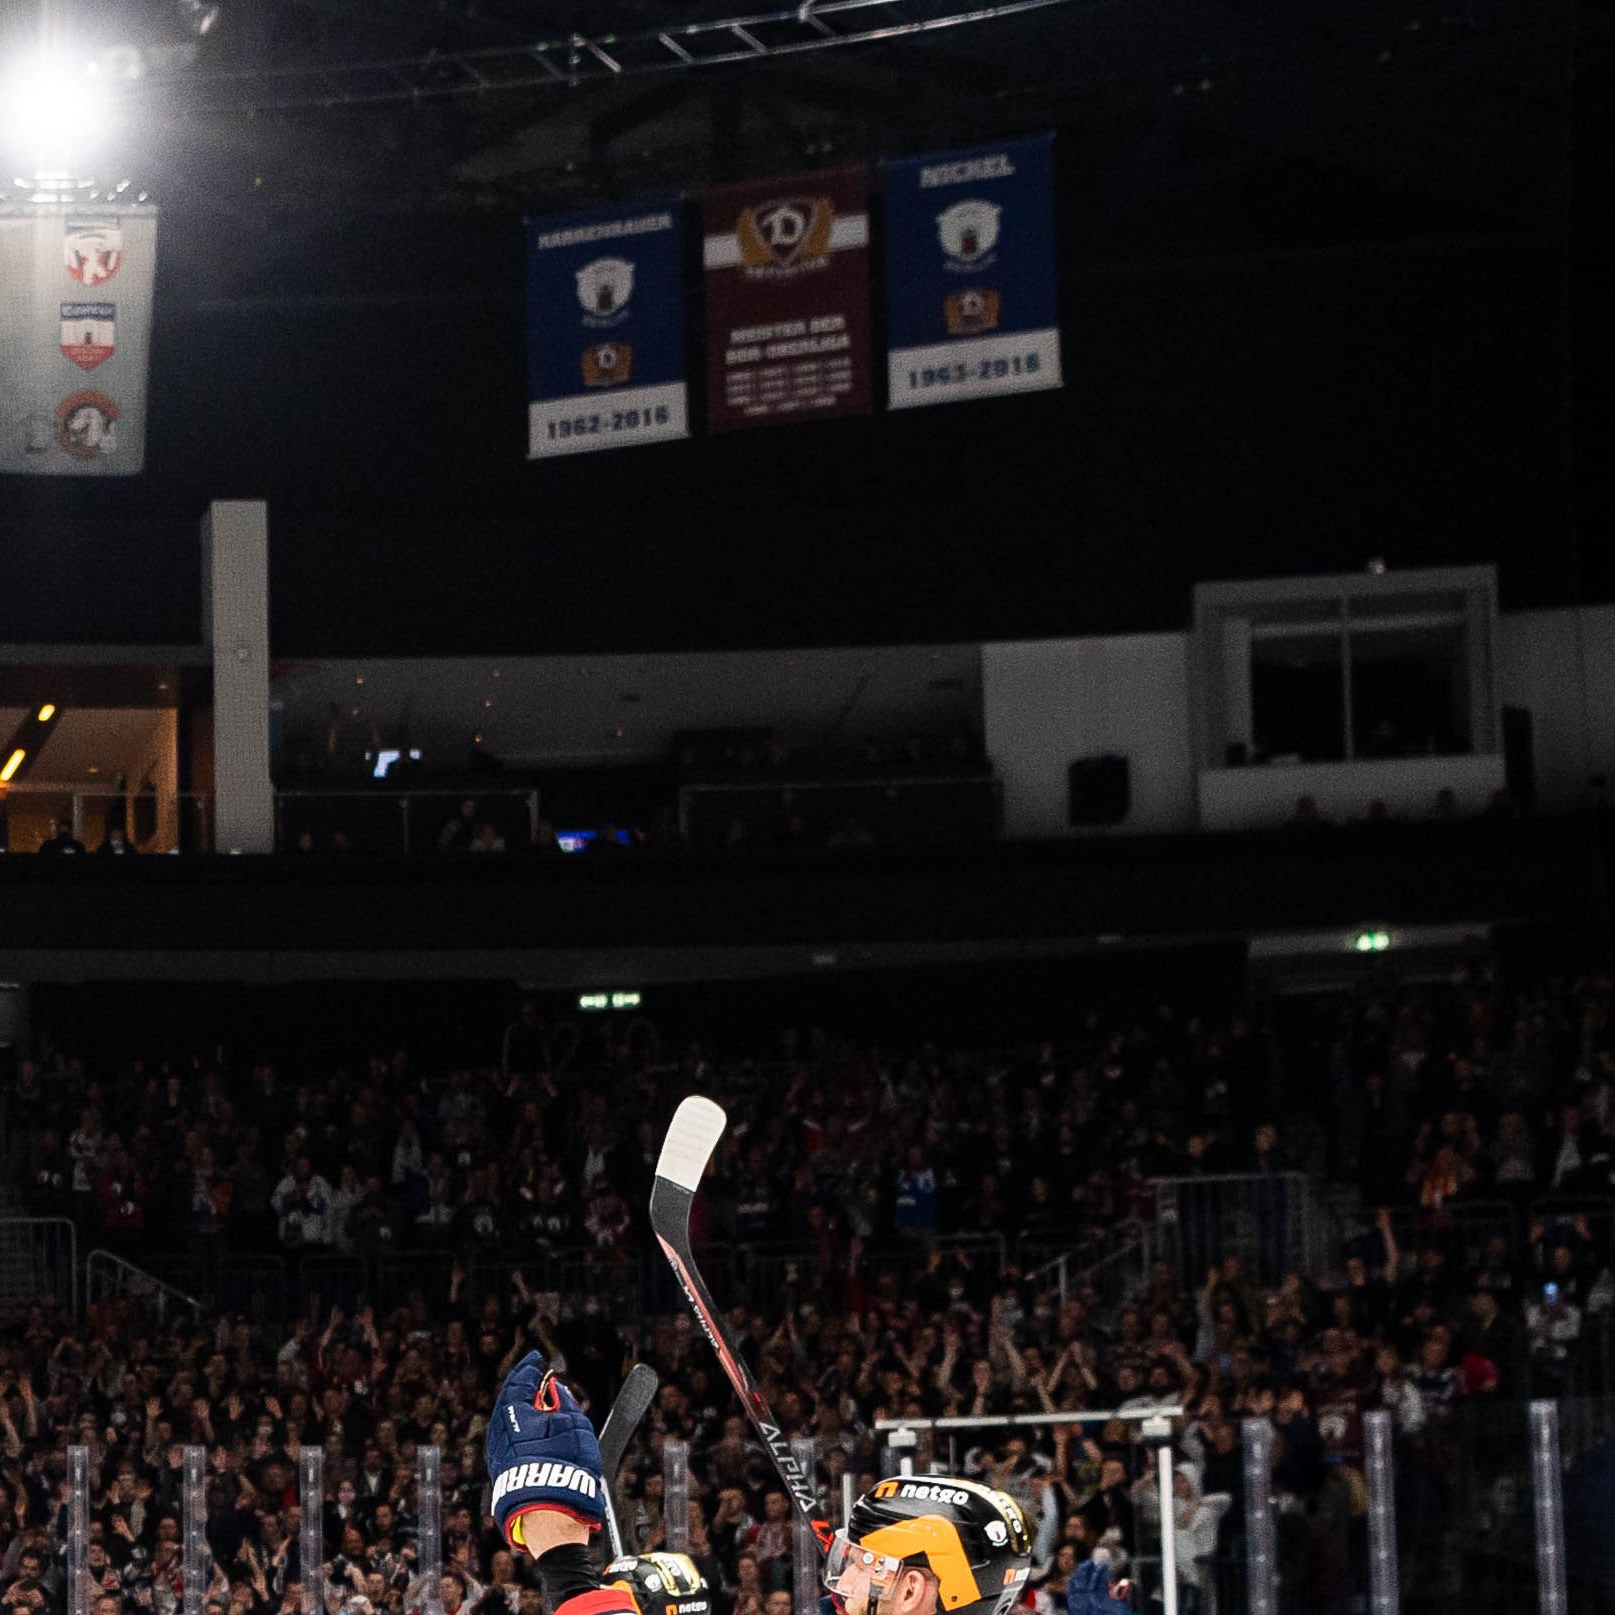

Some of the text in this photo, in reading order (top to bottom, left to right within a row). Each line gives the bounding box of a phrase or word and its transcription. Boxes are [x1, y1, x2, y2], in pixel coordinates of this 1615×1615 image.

[548, 404, 669, 440] 1962-2016
[760, 1422, 817, 1513] ALPHA
[900, 1483, 968, 1506] netgo
